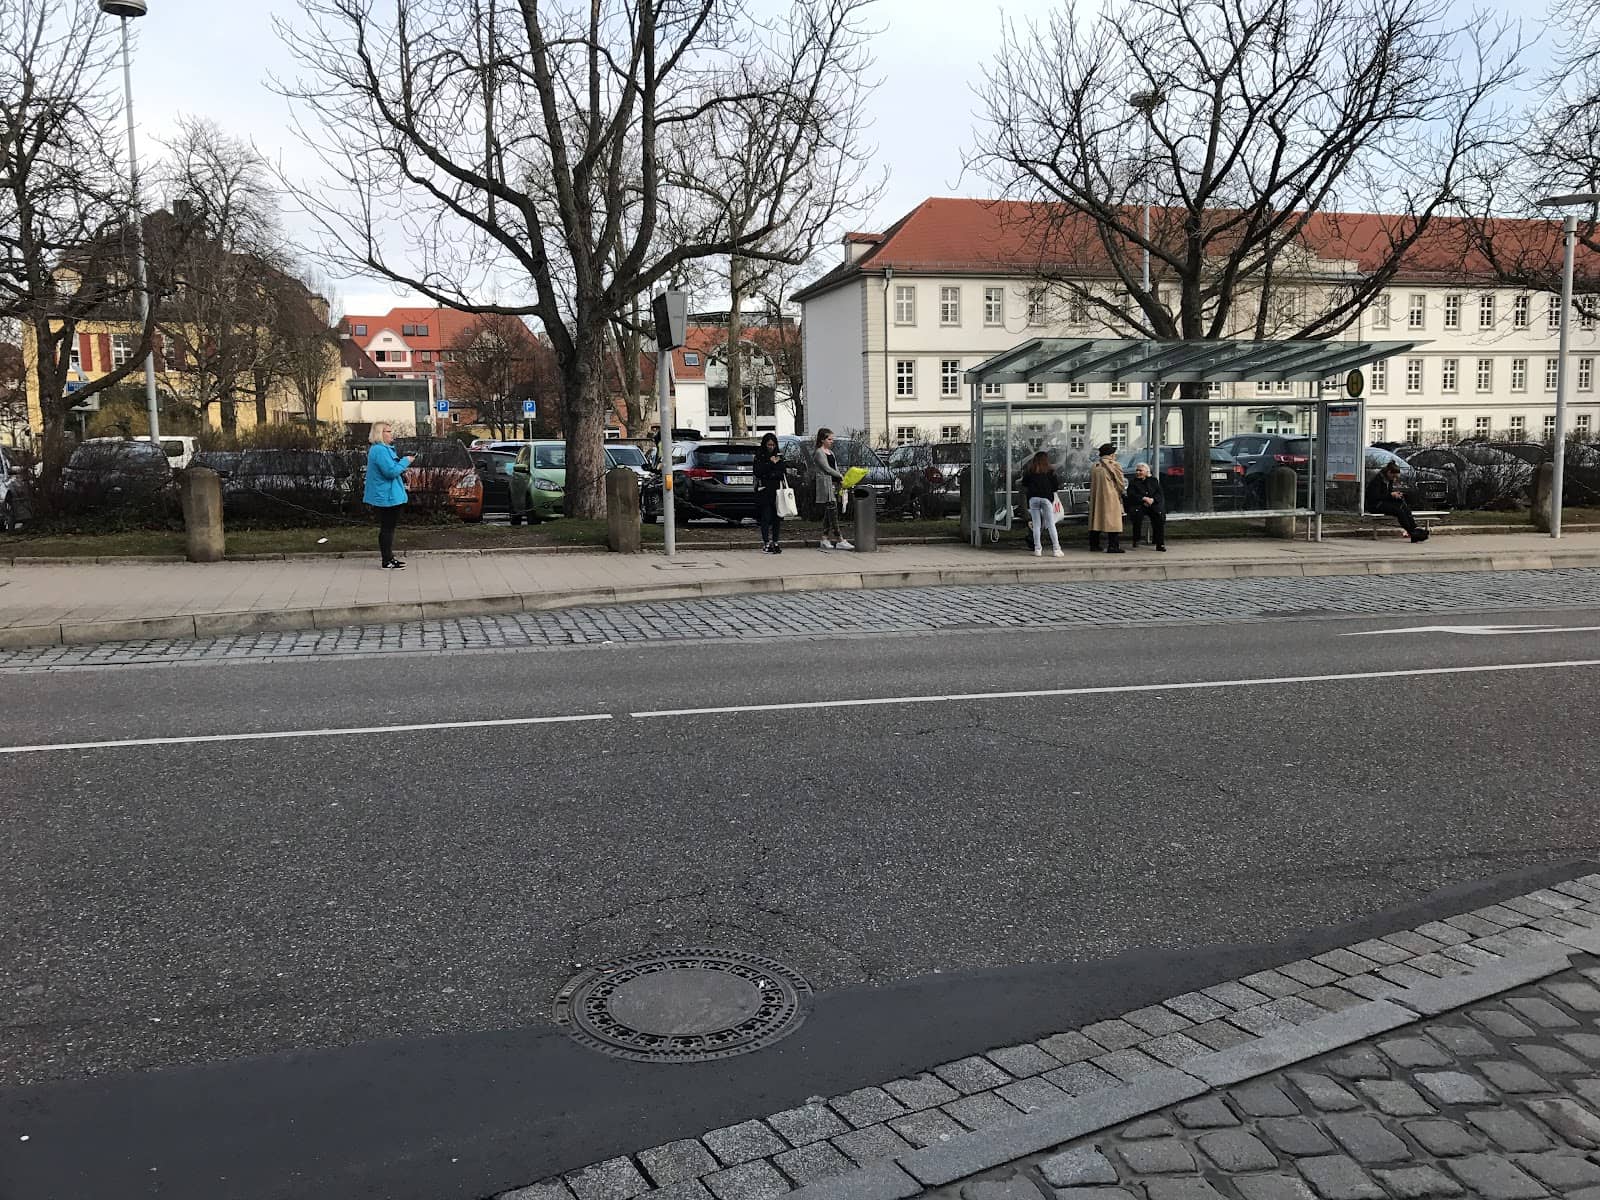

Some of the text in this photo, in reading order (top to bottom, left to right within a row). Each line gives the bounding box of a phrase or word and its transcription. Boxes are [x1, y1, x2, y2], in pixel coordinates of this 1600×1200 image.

[1350, 375, 1360, 392] H
[439, 401, 446, 411] P
[525, 402, 533, 411] P
